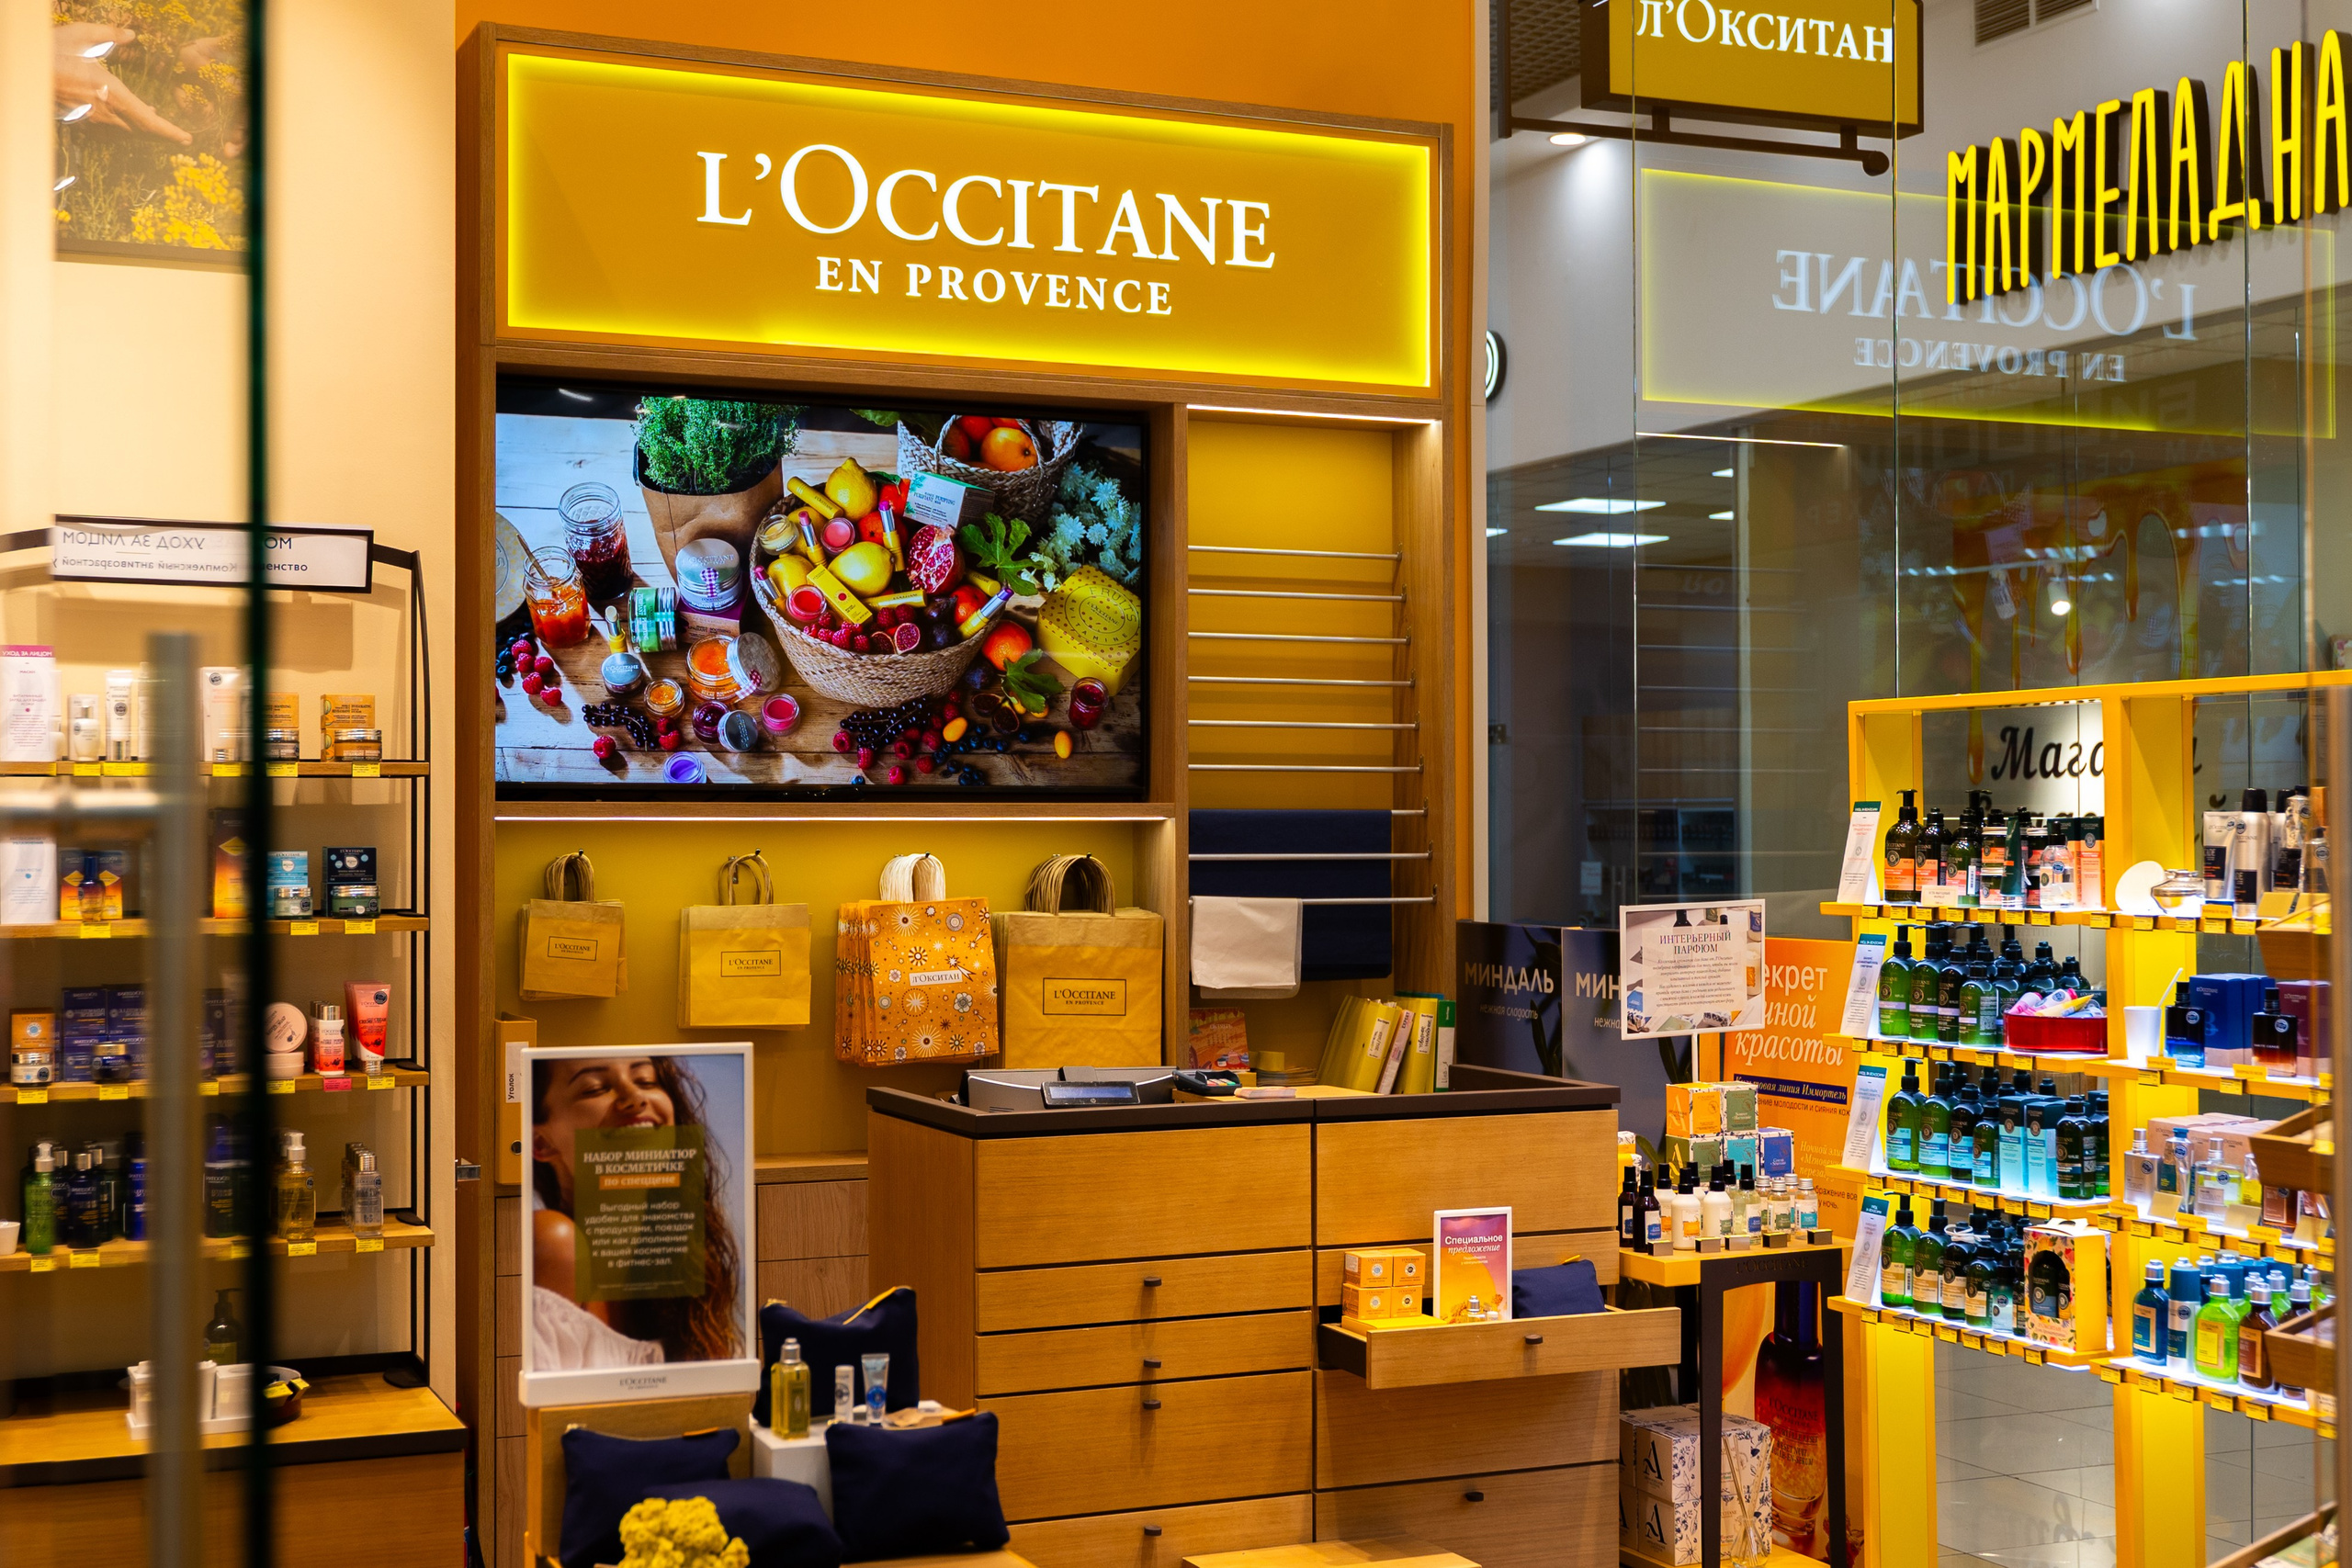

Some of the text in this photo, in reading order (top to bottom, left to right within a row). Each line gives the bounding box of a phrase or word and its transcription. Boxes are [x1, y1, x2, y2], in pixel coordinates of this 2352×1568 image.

[1636, 0, 1893, 63] Л'ОКСИТАН
[1947, 28, 2351, 306] МАРМЕЛАДНА
[696, 144, 1275, 268] L'OCCITANE
[817, 256, 1172, 315] EN PROVENCE
[263, 561, 309, 572] енство
[1089, 587, 1137, 623] FRUITS
[1990, 726, 2105, 780] Мага
[1659, 930, 1731, 944] ИНТЕРЬЕРНЫЙ
[554, 942, 591, 952] L'OCCITANE
[1674, 943, 1718, 954] ПАРФЮМ
[729, 958, 774, 966] L'OCCITANE
[911, 972, 960, 984] Л'ОКСИТАН
[1464, 962, 1555, 996] МИНДАЛЬ
[1576, 972, 1622, 1000] МИН
[1764, 963, 1828, 997] екрет
[1054, 988, 1116, 1000] L'OCCITANE
[1764, 994, 1818, 1030] чной
[1594, 1017, 1622, 1030] нежна
[1735, 1031, 1844, 1066] красоты
[507, 1073, 515, 1100] Уголок
[1777, 1084, 1801, 1095] линия
[1801, 1083, 1847, 1100] Иммортель
[1773, 1099, 1809, 1111] молодости
[1815, 1104, 1838, 1115] сияния
[1838, 1108, 1850, 1117] кож
[583, 1148, 696, 1163] НАБОР МИНИАТЮР
[1801, 1140, 1844, 1157] Ночной эли
[594, 1161, 685, 1175] В КОСМЕТИЧКЕ
[1814, 1185, 1845, 1199] бражение
[1445, 1235, 1503, 1245] Специальное
[1448, 1244, 1500, 1256] предложение
